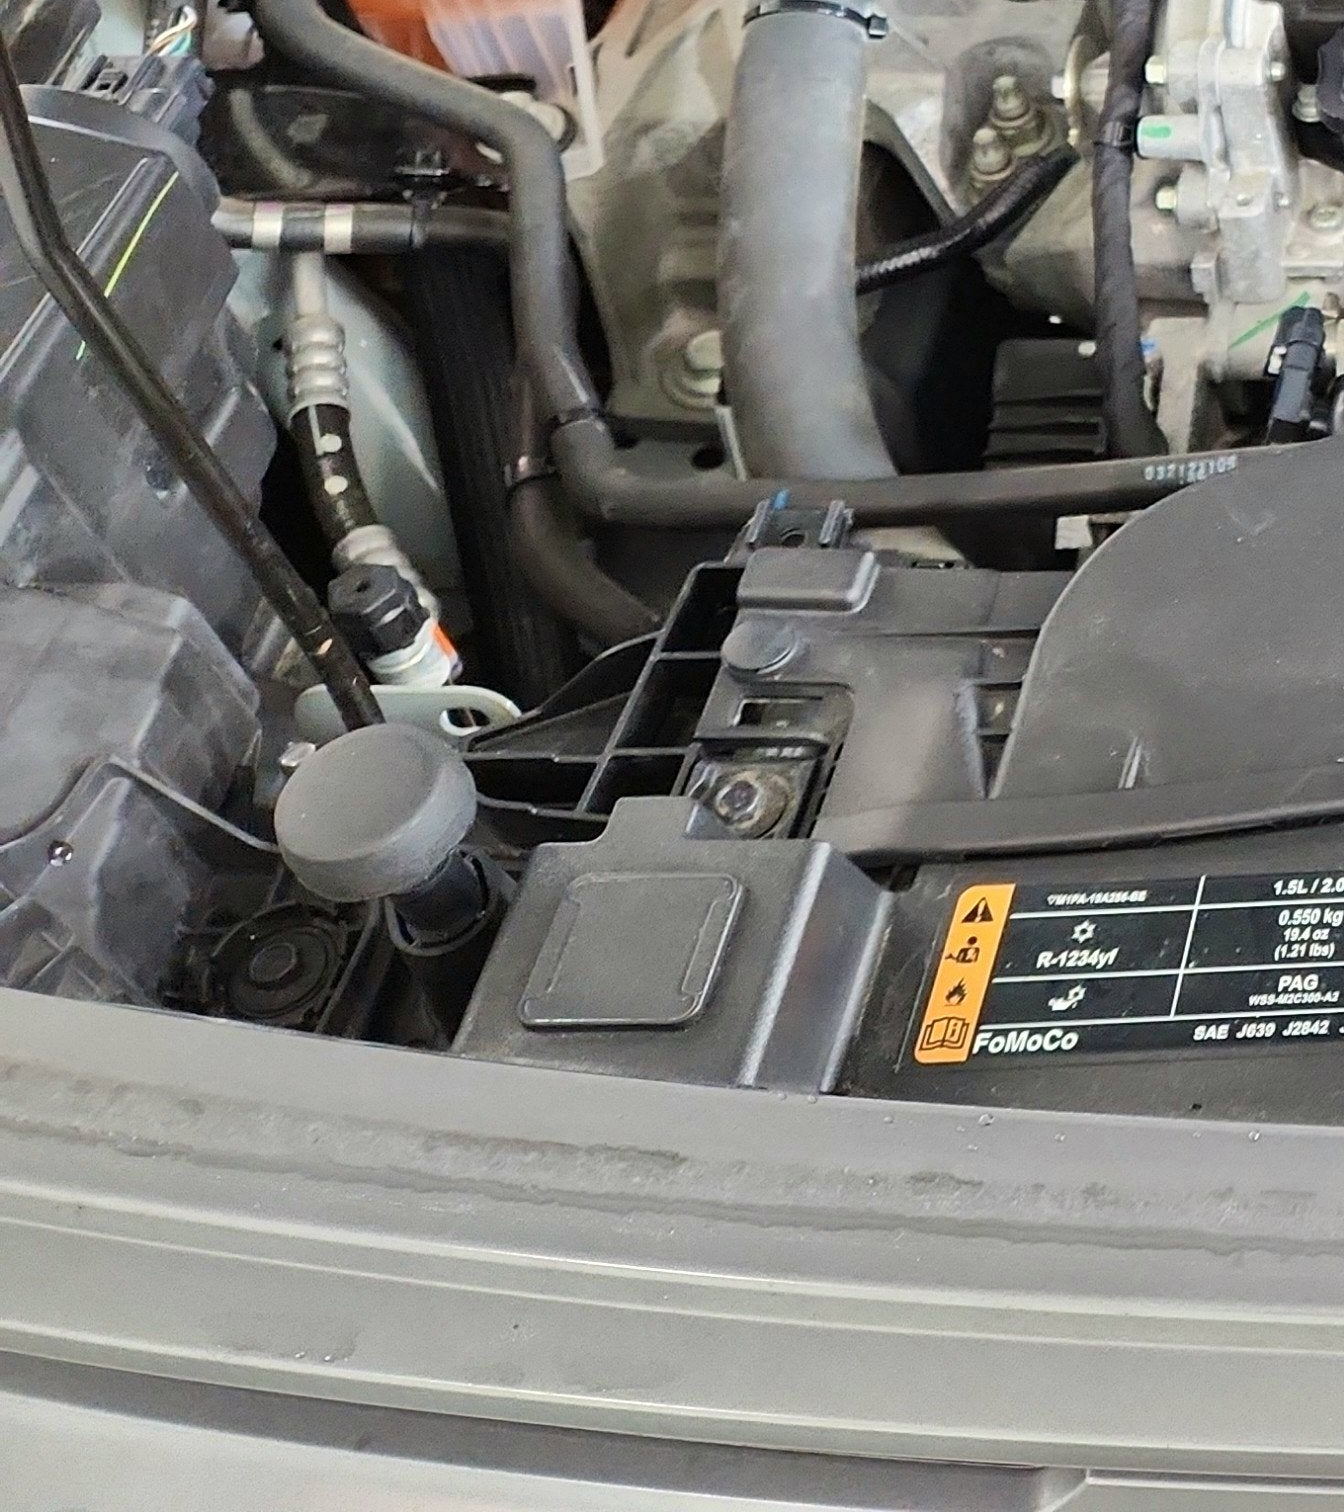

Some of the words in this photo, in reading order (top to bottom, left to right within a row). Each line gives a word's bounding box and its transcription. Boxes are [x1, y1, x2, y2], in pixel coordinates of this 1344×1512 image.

[1274, 879, 1308, 896] 1.5L
[1309, 878, 1320, 894] /
[1278, 909, 1321, 926] 0.550
[1323, 908, 1344, 926] kg
[1283, 928, 1311, 942] 19.4
[1312, 928, 1331, 941] oz
[1035, 947, 1120, 969] R-1234yf
[1274, 944, 1307, 961] (1.21
[1308, 942, 1335, 959] lbs)
[1278, 974, 1319, 992] PAG
[1193, 1024, 1230, 1041] SAE
[1235, 1022, 1276, 1039] J639
[1281, 1020, 1332, 1037] J2842
[971, 1028, 1080, 1055] FoMoCo
